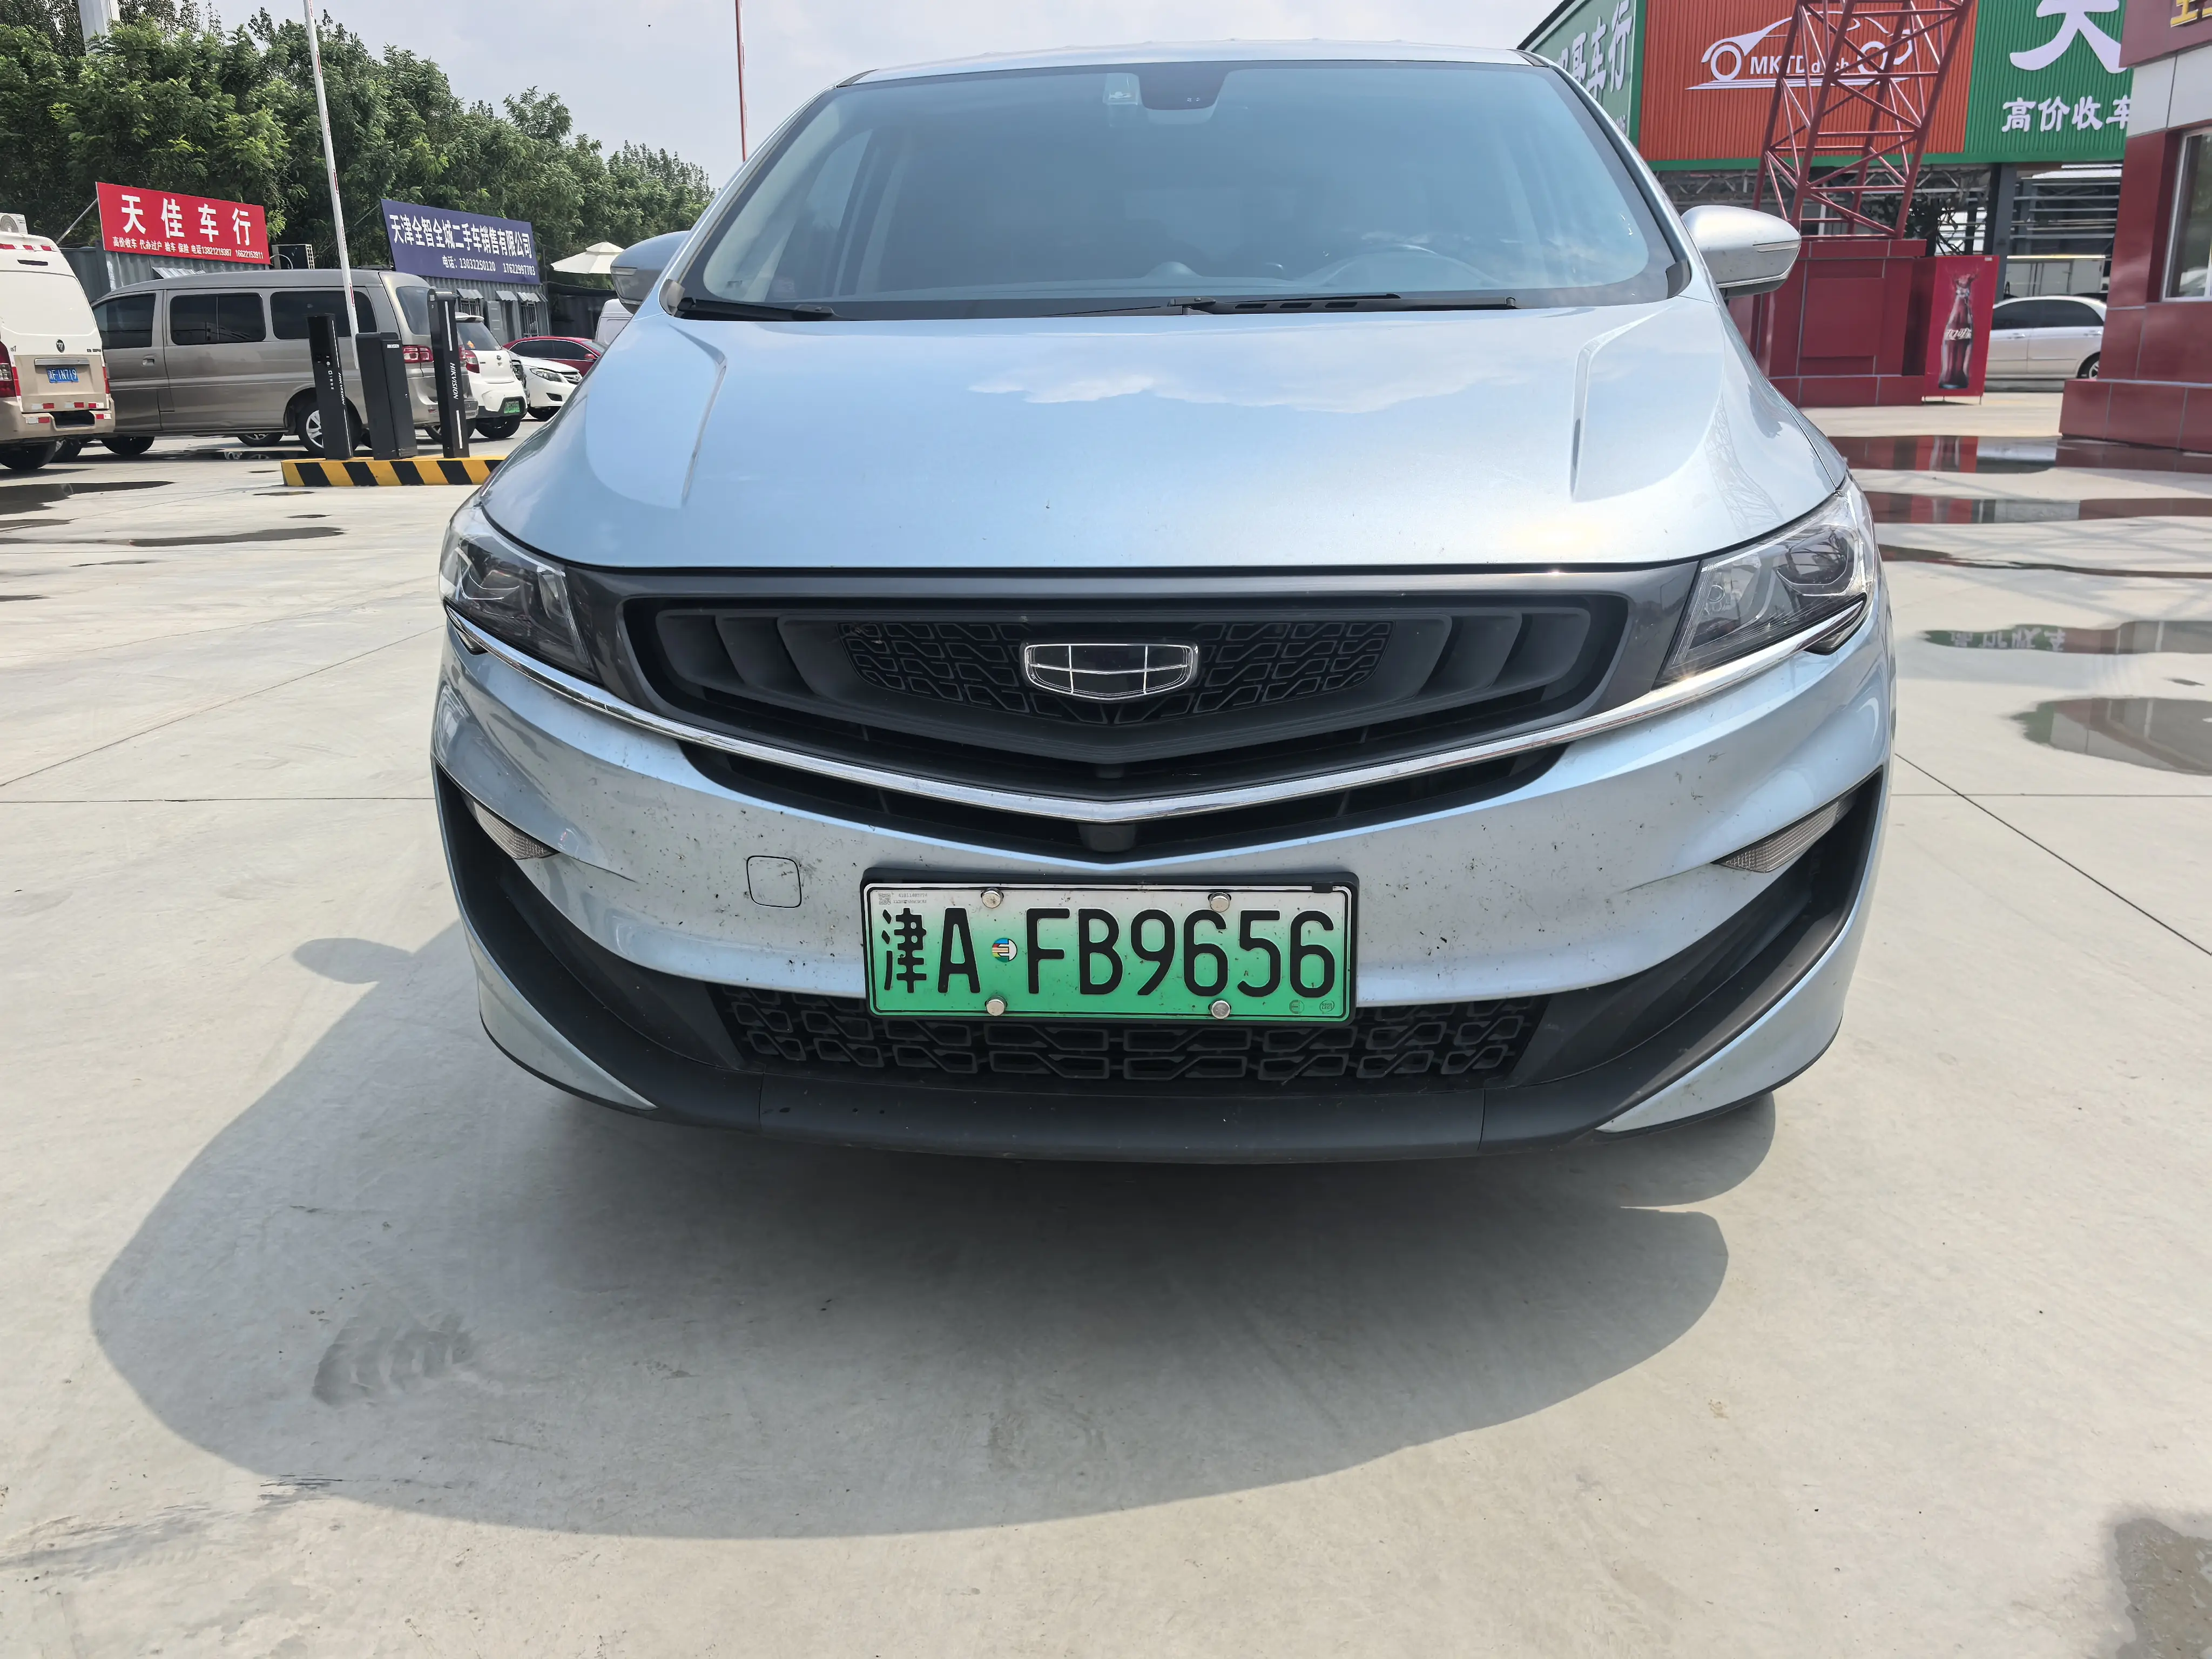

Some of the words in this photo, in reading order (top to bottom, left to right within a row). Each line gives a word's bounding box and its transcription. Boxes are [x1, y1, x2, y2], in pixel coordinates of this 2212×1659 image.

[1557, 0, 1633, 101] 哥车行
[2001, 95, 2130, 132] 高价收车
[121, 194, 251, 246] 天佳车行
[389, 214, 532, 259] 天津全智全城二手车销售有限公司
[112, 236, 138, 249] 高价收车
[140, 239, 162, 251] 代办过户
[178, 242, 190, 253] 保险
[503, 262, 536, 276] 17622997703
[450, 362, 458, 400] HIKVISION
